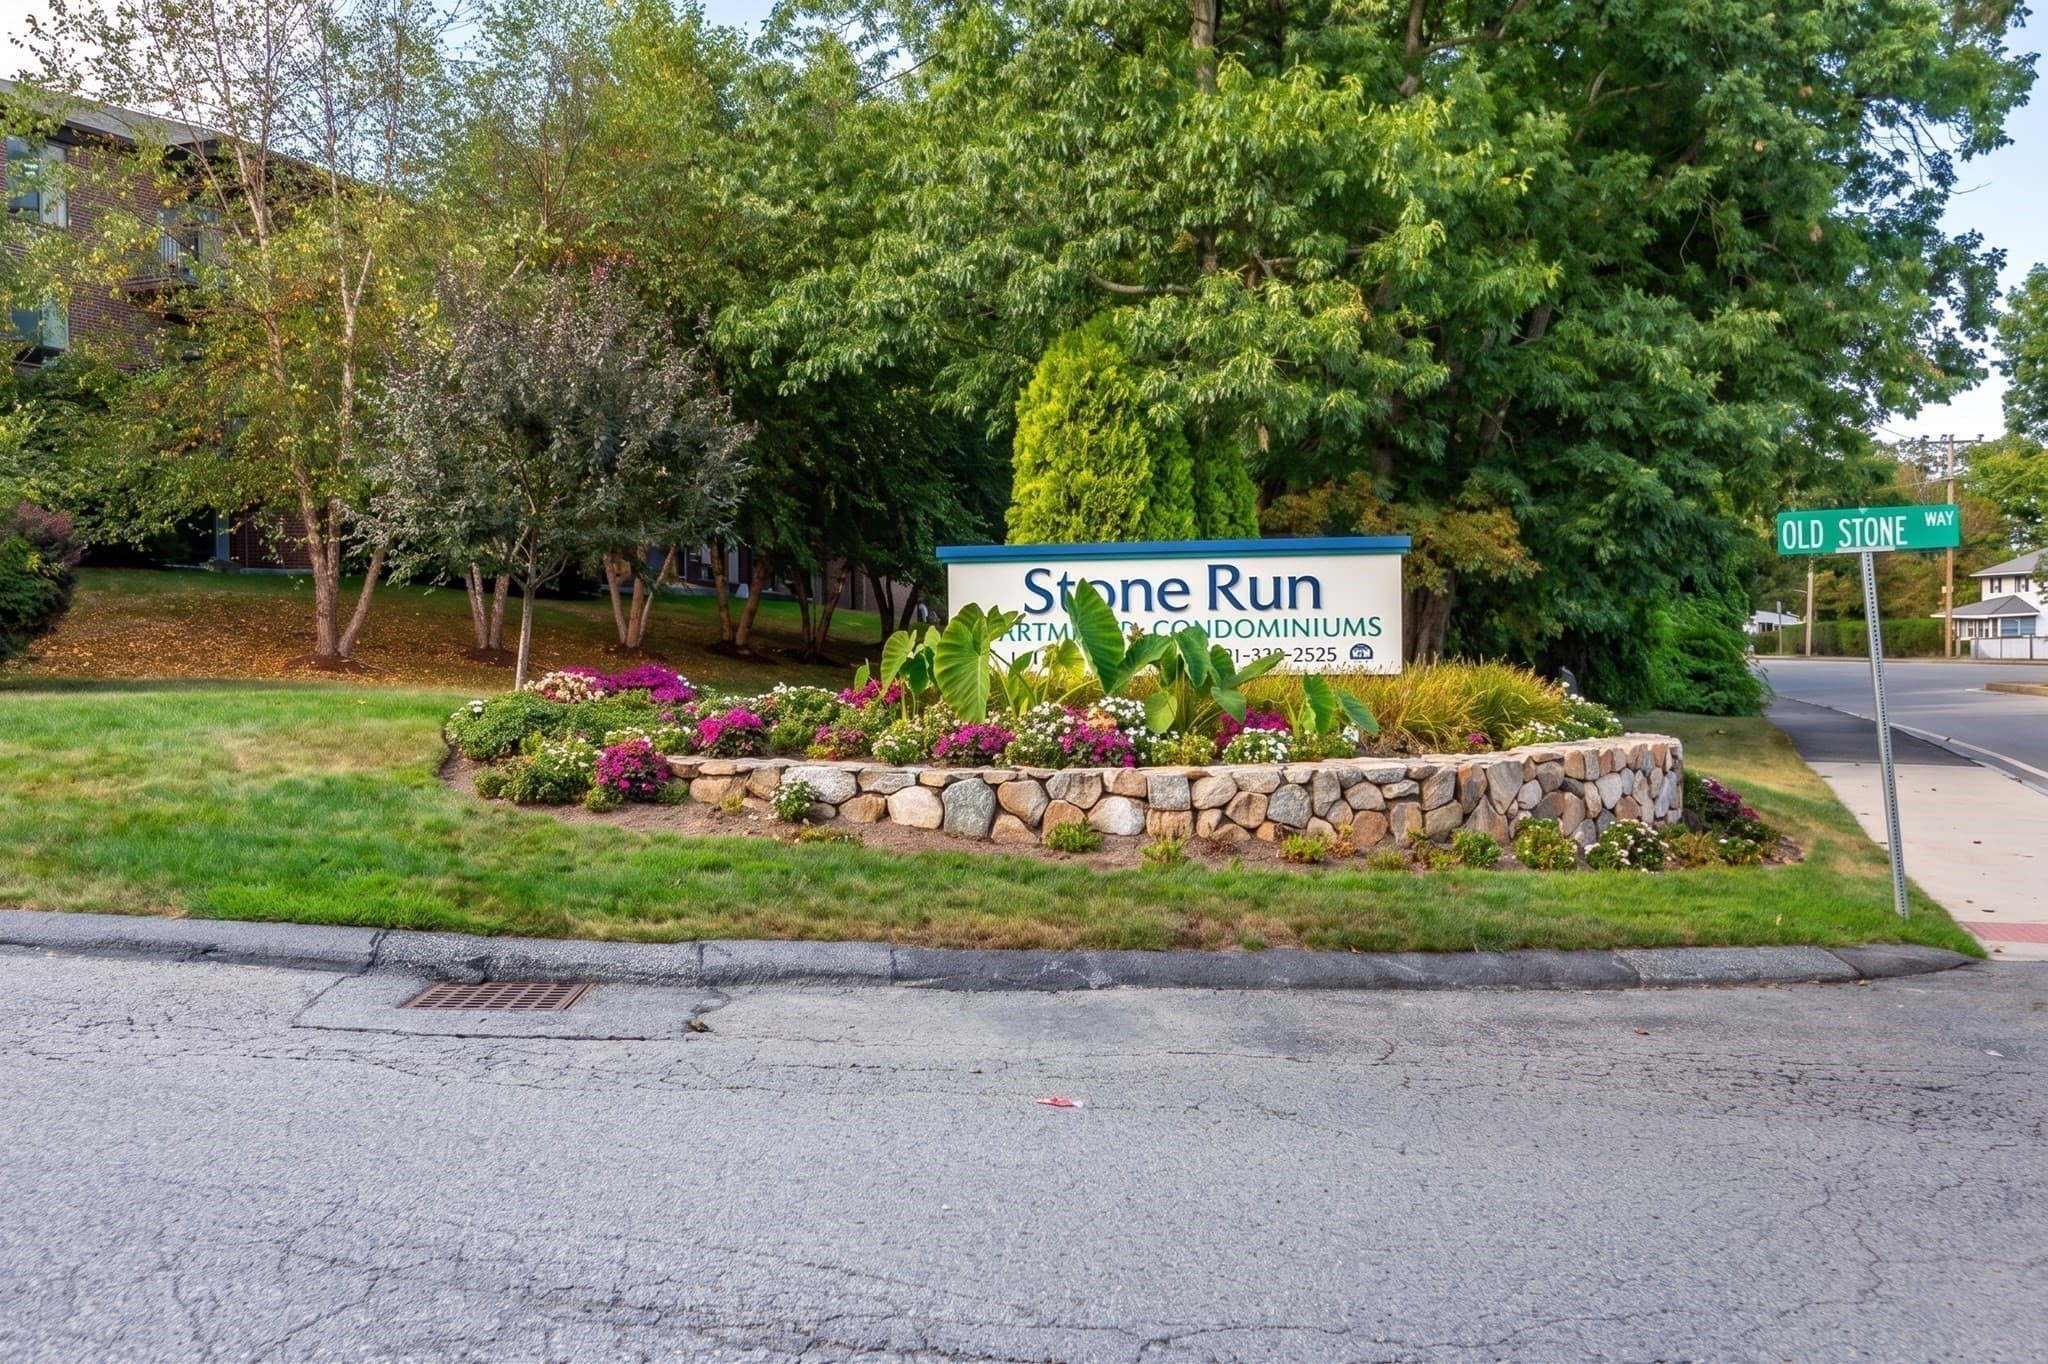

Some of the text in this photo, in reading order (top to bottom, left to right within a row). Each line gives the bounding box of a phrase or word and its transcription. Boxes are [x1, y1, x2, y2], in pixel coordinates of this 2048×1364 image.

[1782, 510, 1955, 549] OLD STONE WAY
[1207, 563, 1323, 612] Run
